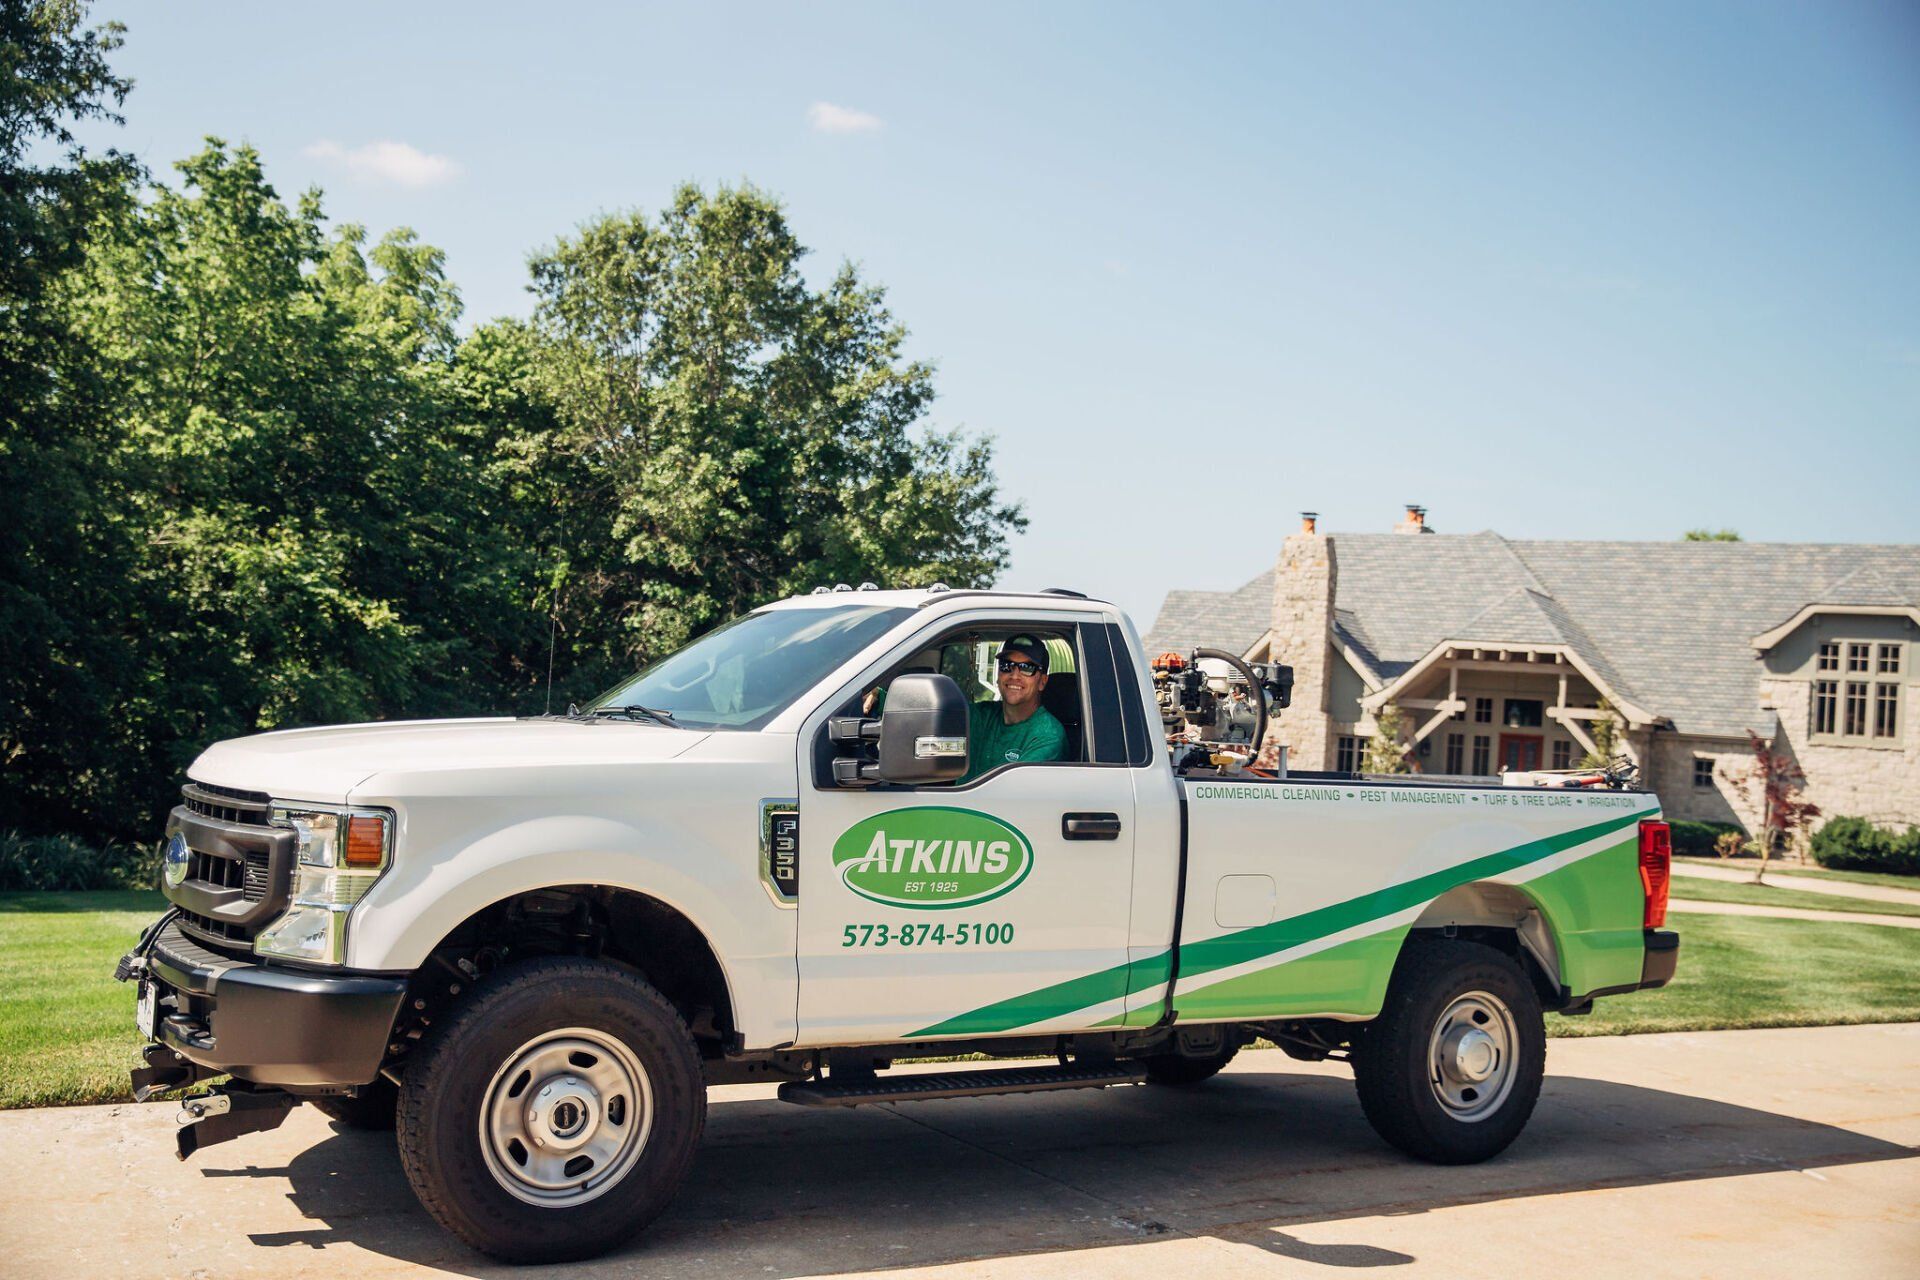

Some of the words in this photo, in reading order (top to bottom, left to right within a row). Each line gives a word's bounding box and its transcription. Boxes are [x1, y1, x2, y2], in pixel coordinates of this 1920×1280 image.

[1196, 786, 1279, 800] COMMERCIAL
[1282, 788, 1341, 801] CLEANING
[1360, 790, 1387, 802] PEST
[1391, 791, 1466, 804] MANAGEMENT
[1483, 794, 1509, 805] TURF
[1511, 795, 1519, 806] &
[1521, 795, 1545, 807] TREE
[1547, 796, 1572, 807] CARE
[1587, 796, 1636, 808] IRRIGATION
[857, 830, 1011, 874] ATKINS
[904, 881, 927, 893] EST
[929, 881, 959, 893] 1925
[841, 922, 1015, 947] 573-874-5100
